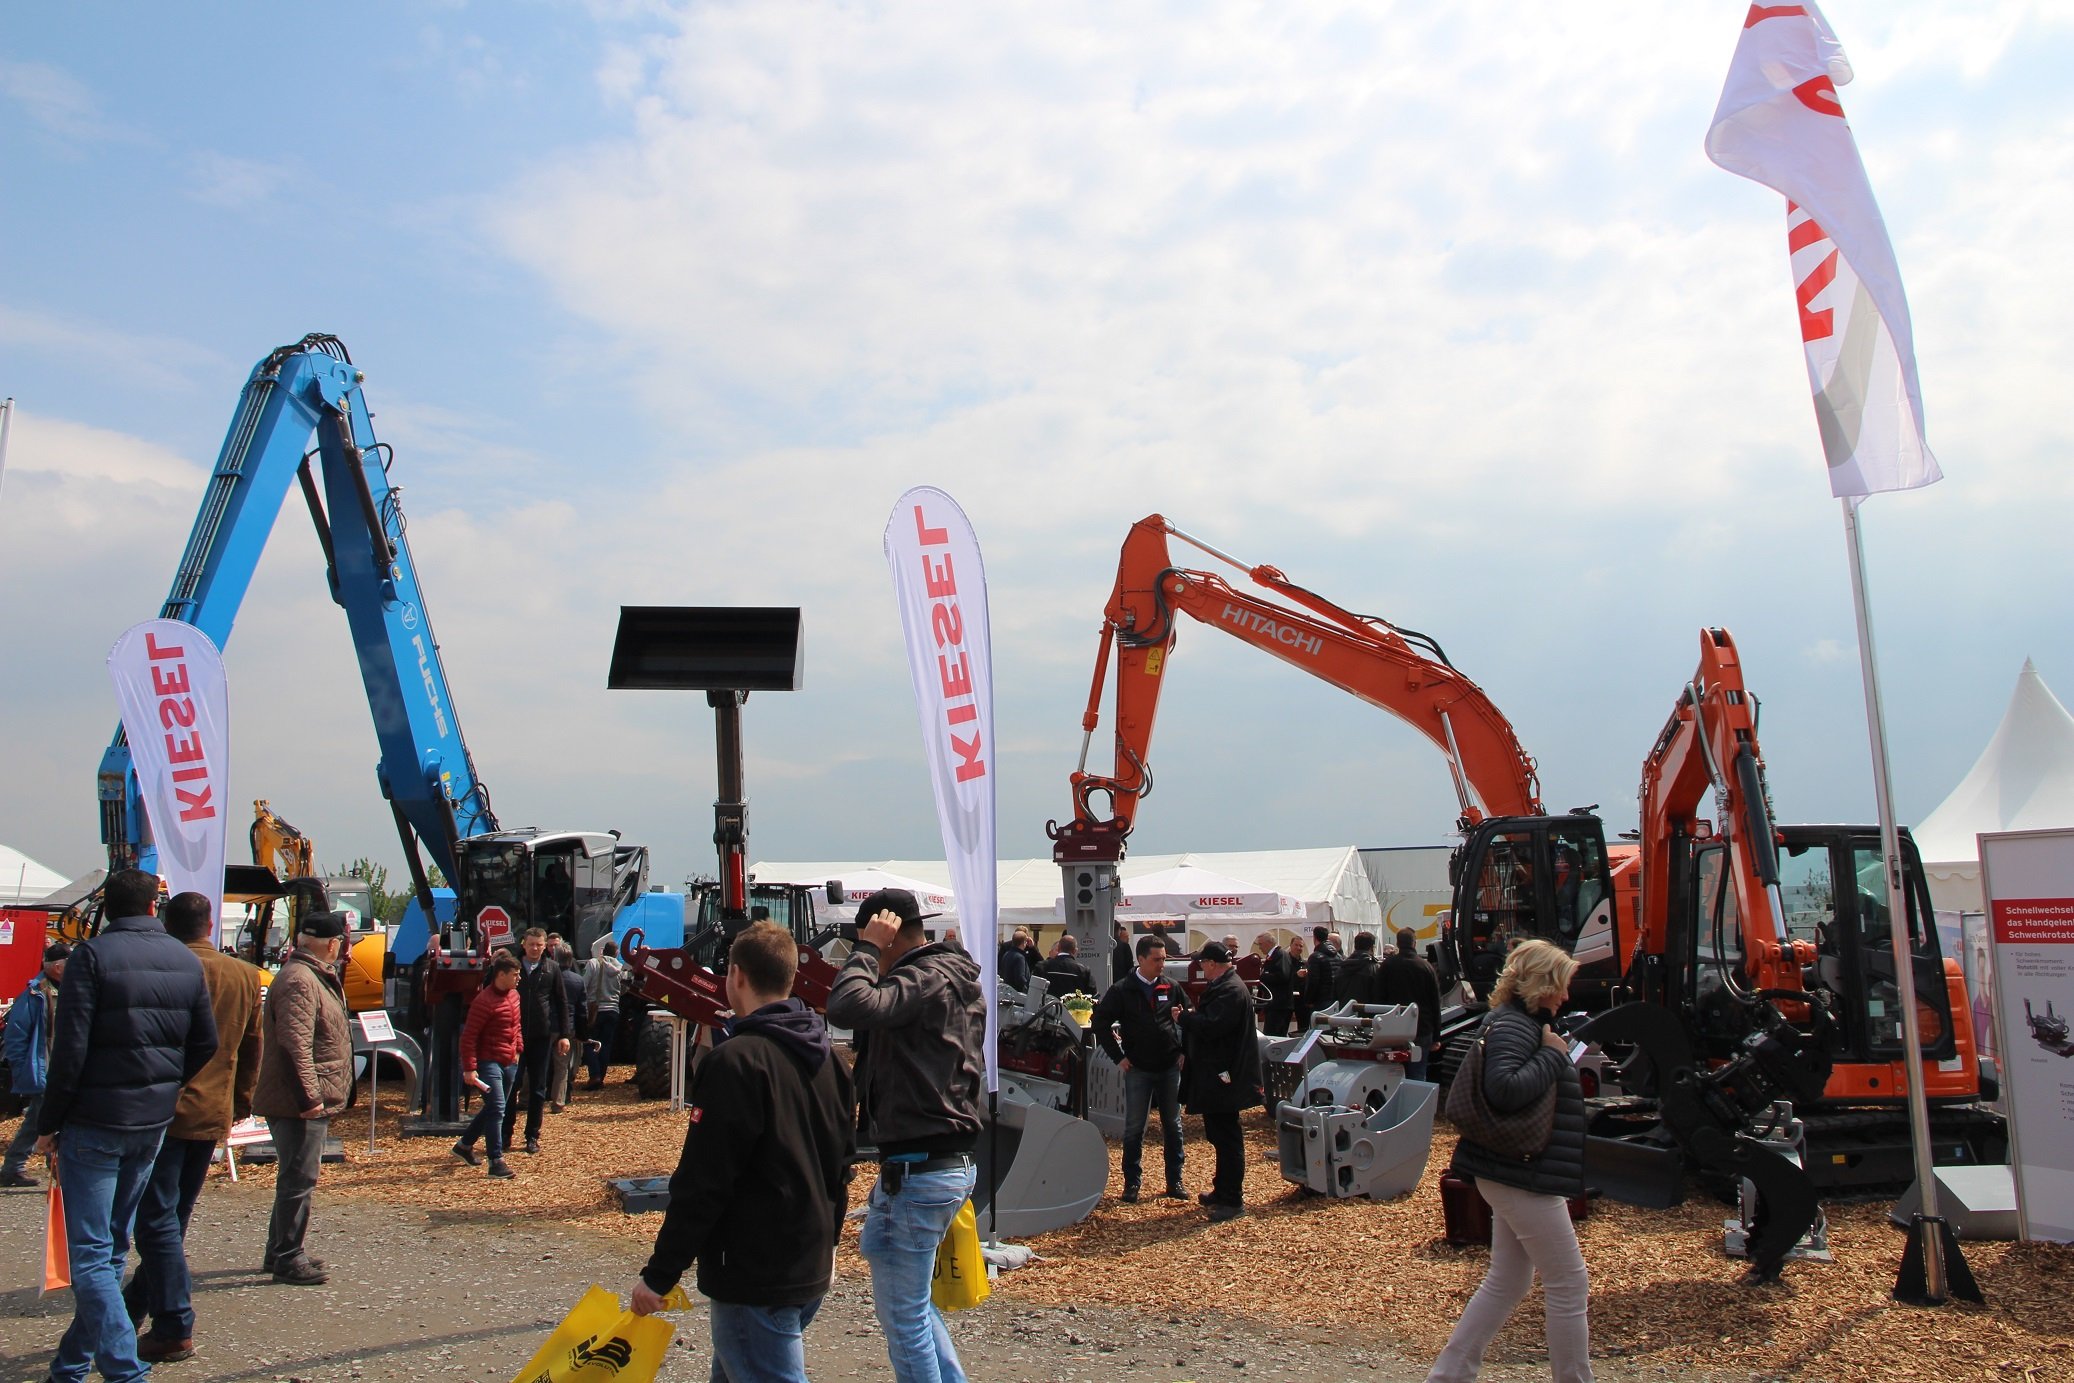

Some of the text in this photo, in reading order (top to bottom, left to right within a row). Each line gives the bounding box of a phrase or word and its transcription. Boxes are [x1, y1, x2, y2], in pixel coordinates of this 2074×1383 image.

[1221, 603, 1324, 656] HITACHI
[411, 633, 449, 739] FUCHS
[851, 891, 876, 900] KIES
[928, 894, 946, 905] KIESEL
[1199, 897, 1243, 906] KIESEL
[2007, 919, 2023, 927] das
